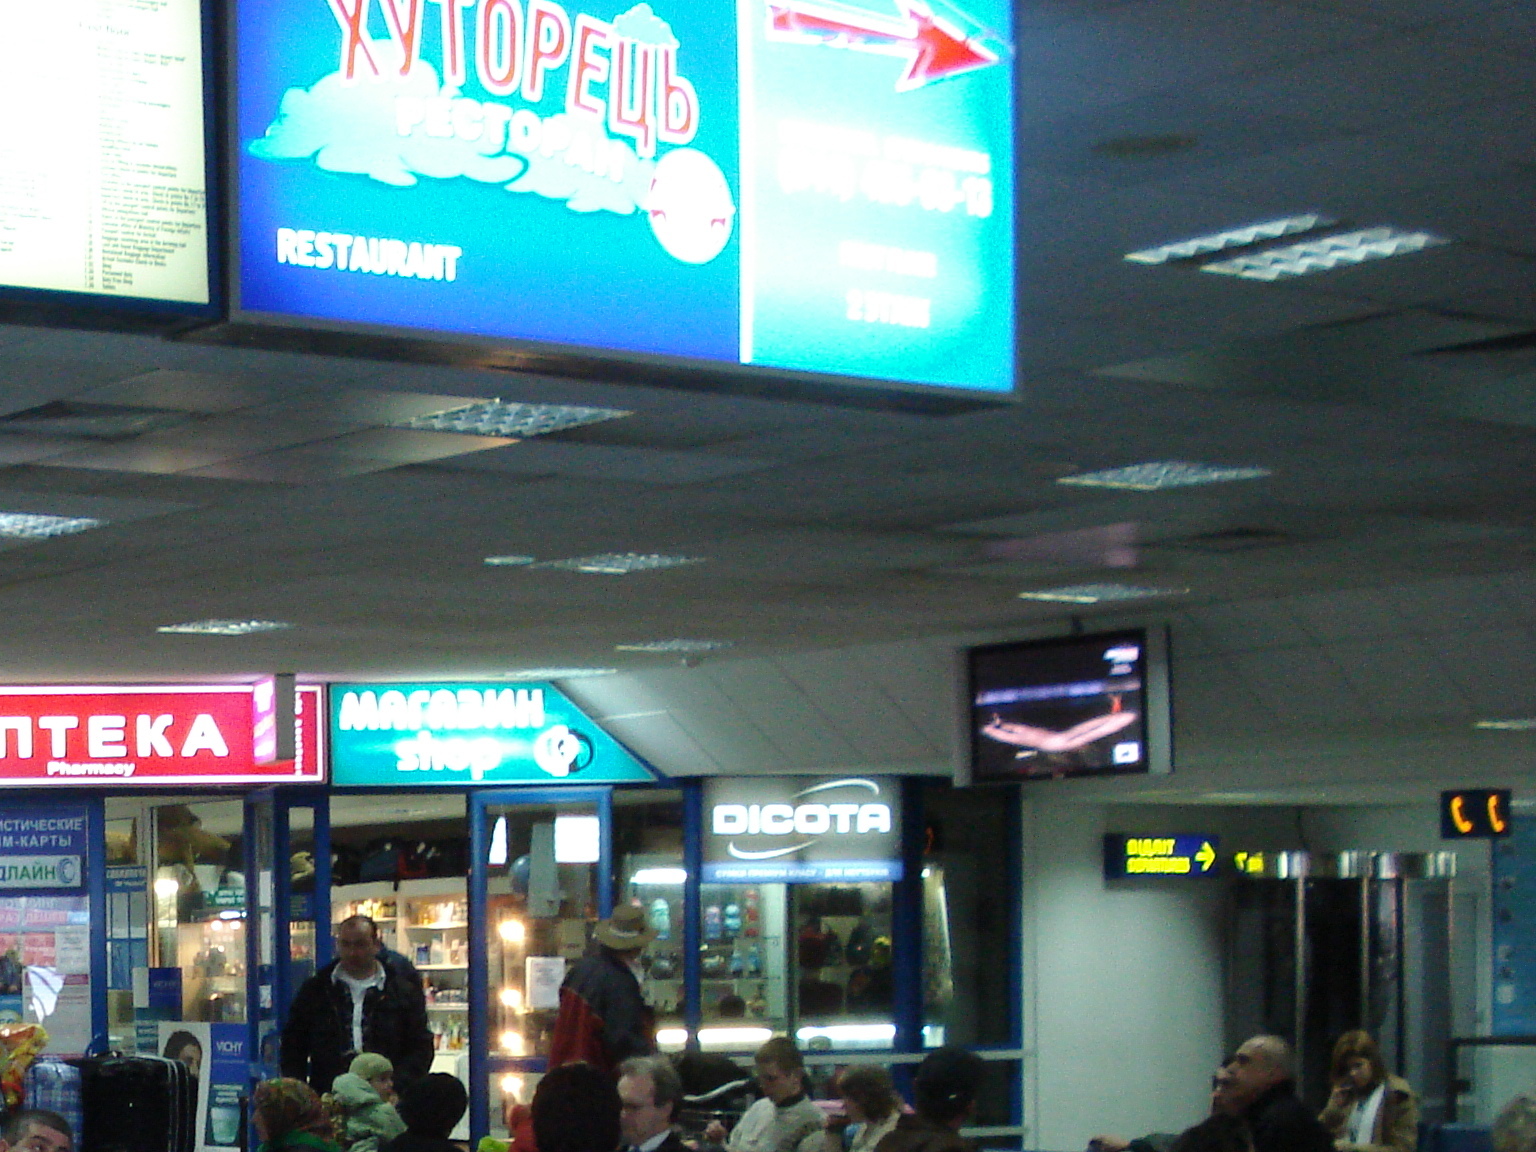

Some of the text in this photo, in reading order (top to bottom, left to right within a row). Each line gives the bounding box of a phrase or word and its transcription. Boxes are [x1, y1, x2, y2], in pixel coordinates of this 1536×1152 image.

[395, 96, 627, 183] РЕСТОРАН
[277, 228, 462, 282] RESTAURANT
[46, 760, 136, 777] Pharmacy
[394, 730, 503, 780] shop
[712, 803, 891, 835] DICOTA
[215, 1041, 243, 1052] VICHY
